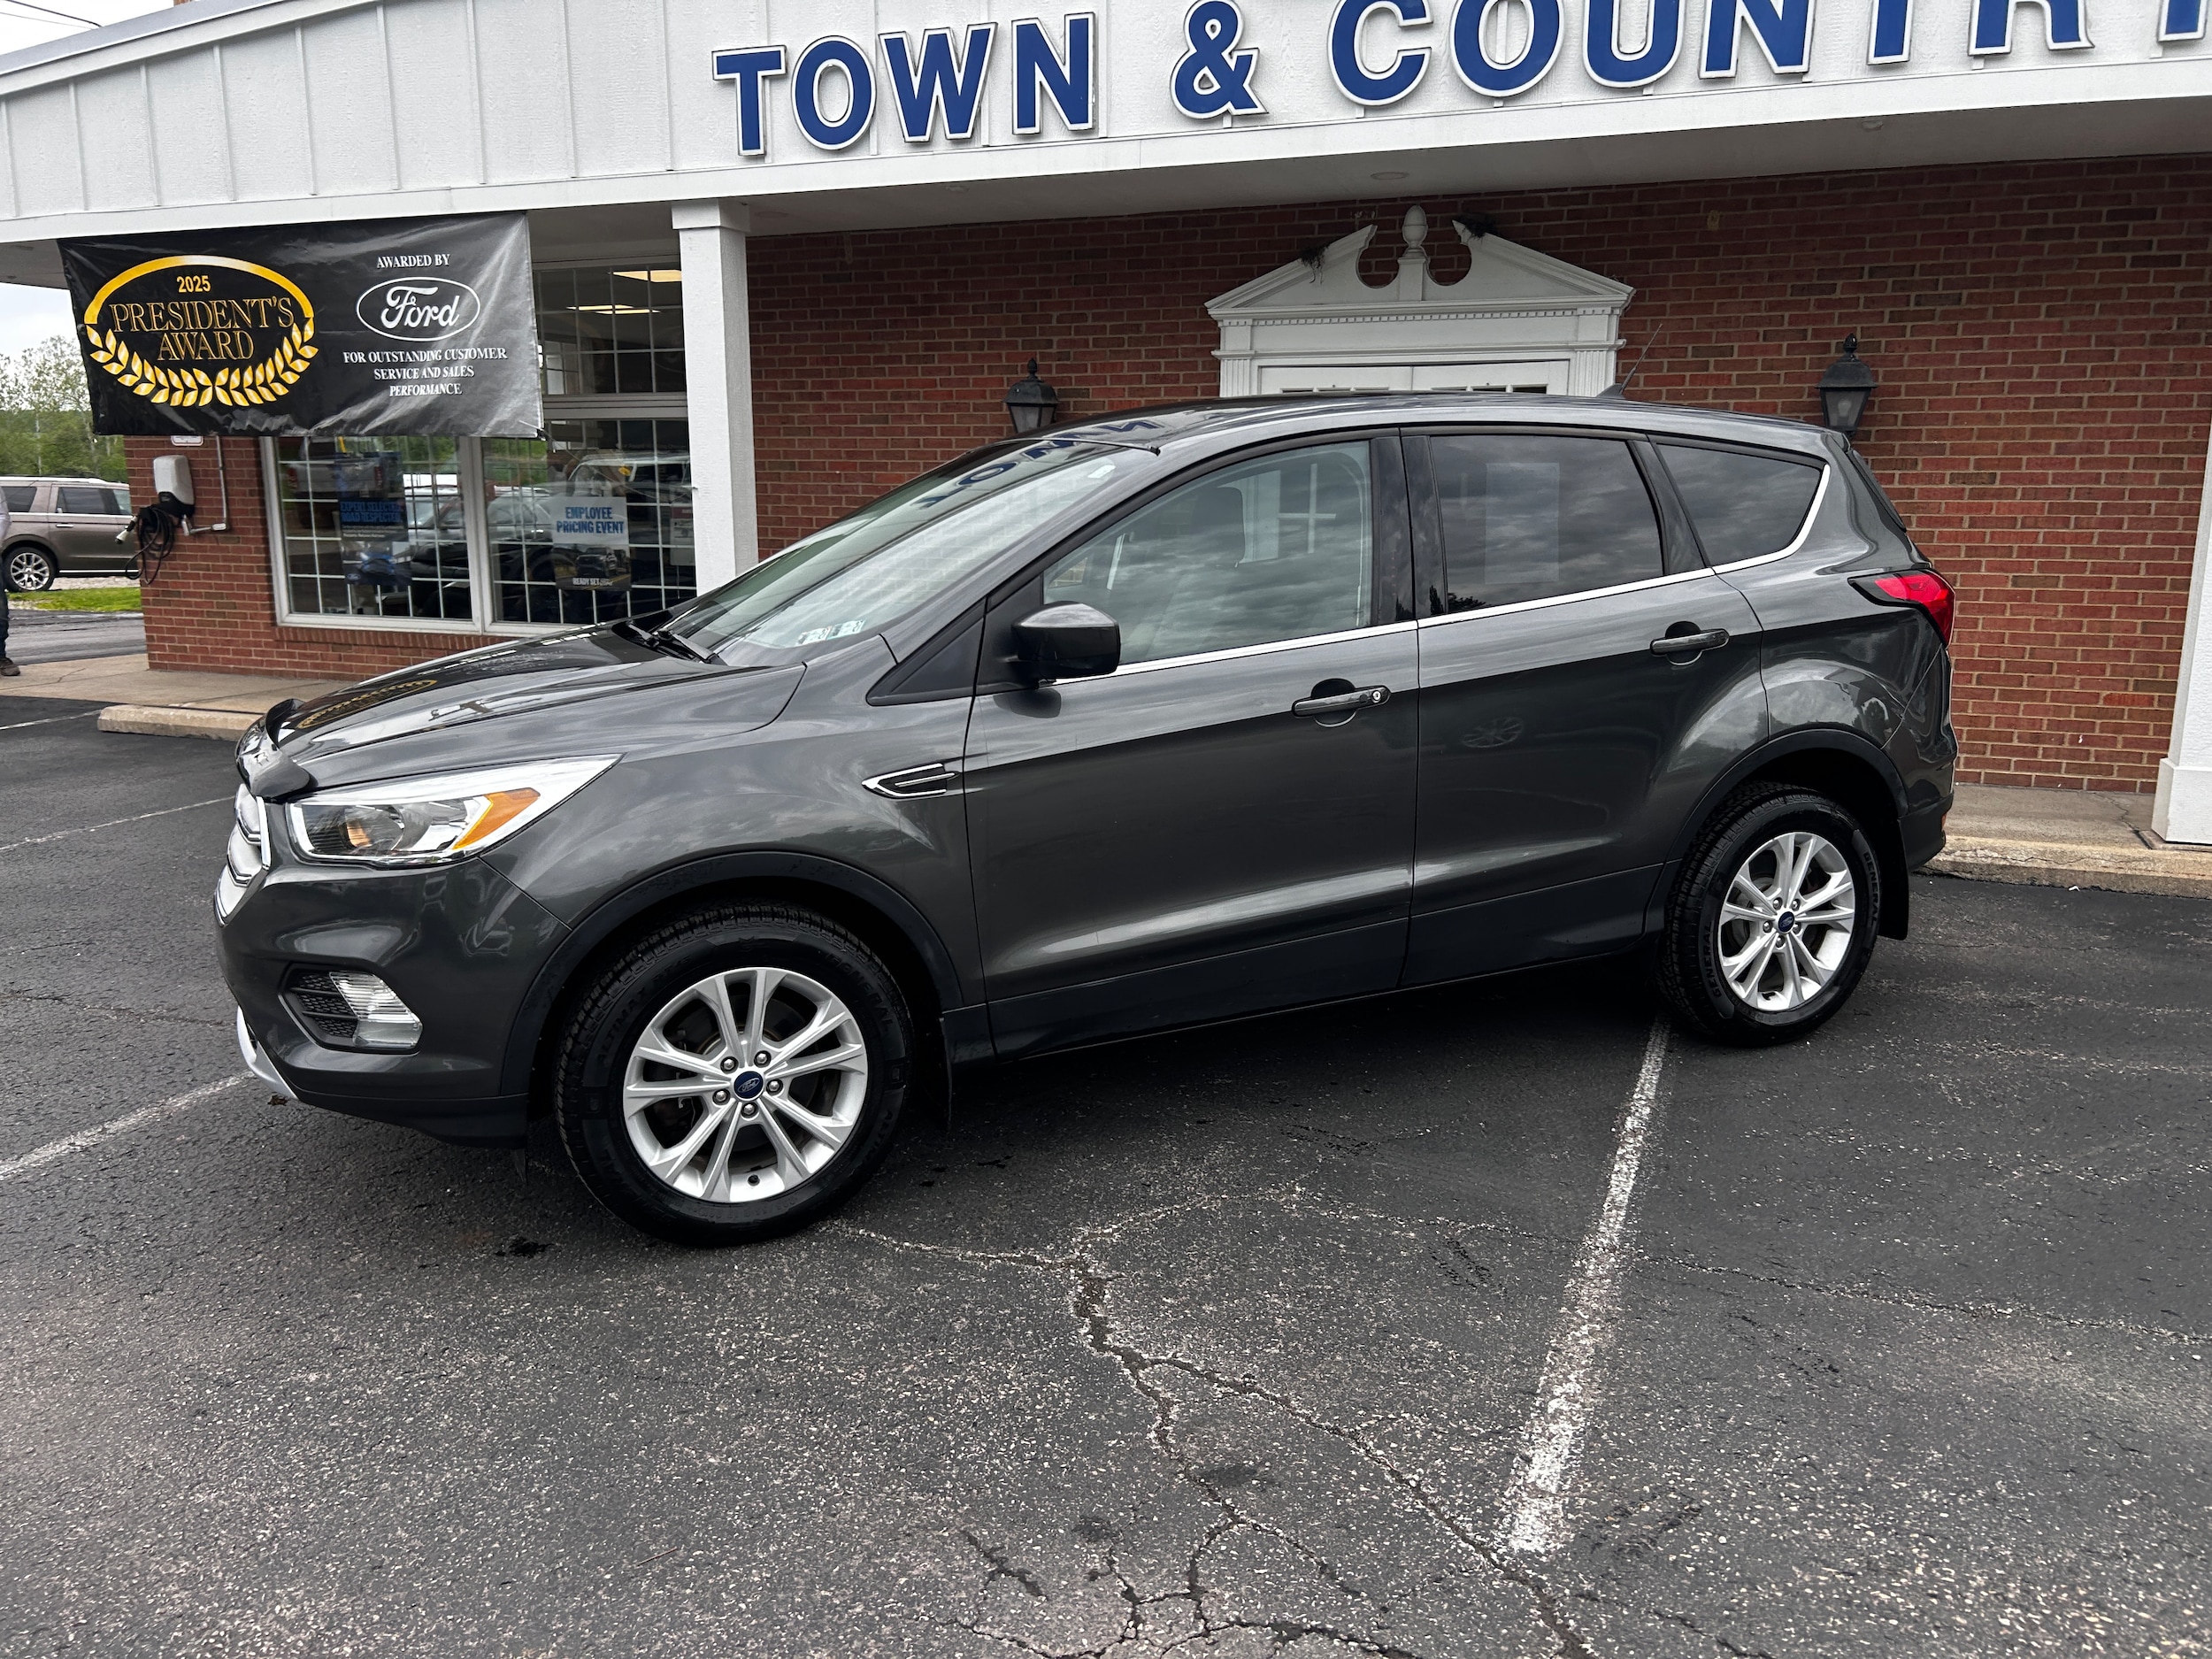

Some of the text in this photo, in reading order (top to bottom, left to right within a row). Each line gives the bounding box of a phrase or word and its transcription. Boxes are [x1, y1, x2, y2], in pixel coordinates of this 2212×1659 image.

[712, 11, 1096, 157] TOWN
[1171, 0, 1268, 119] &
[376, 253, 450, 269] AWARDED BY
[176, 275, 212, 293] 2025
[109, 296, 296, 333] PRESIDENT'S
[380, 285, 461, 329] Ford
[157, 330, 255, 362] AWARD
[342, 347, 508, 364] FOR OUTSTANDING CUSTOMER
[373, 365, 475, 380] SERVICE AND SALES
[388, 382, 462, 397] PERFORMANCE
[565, 506, 613, 519] EMPLOYEE
[556, 520, 625, 534] PRICING EVENT
[1863, 850, 1879, 926] GENERAL
[1703, 920, 1723, 998] GENERAL
[823, 952, 895, 1031] GENERAL
